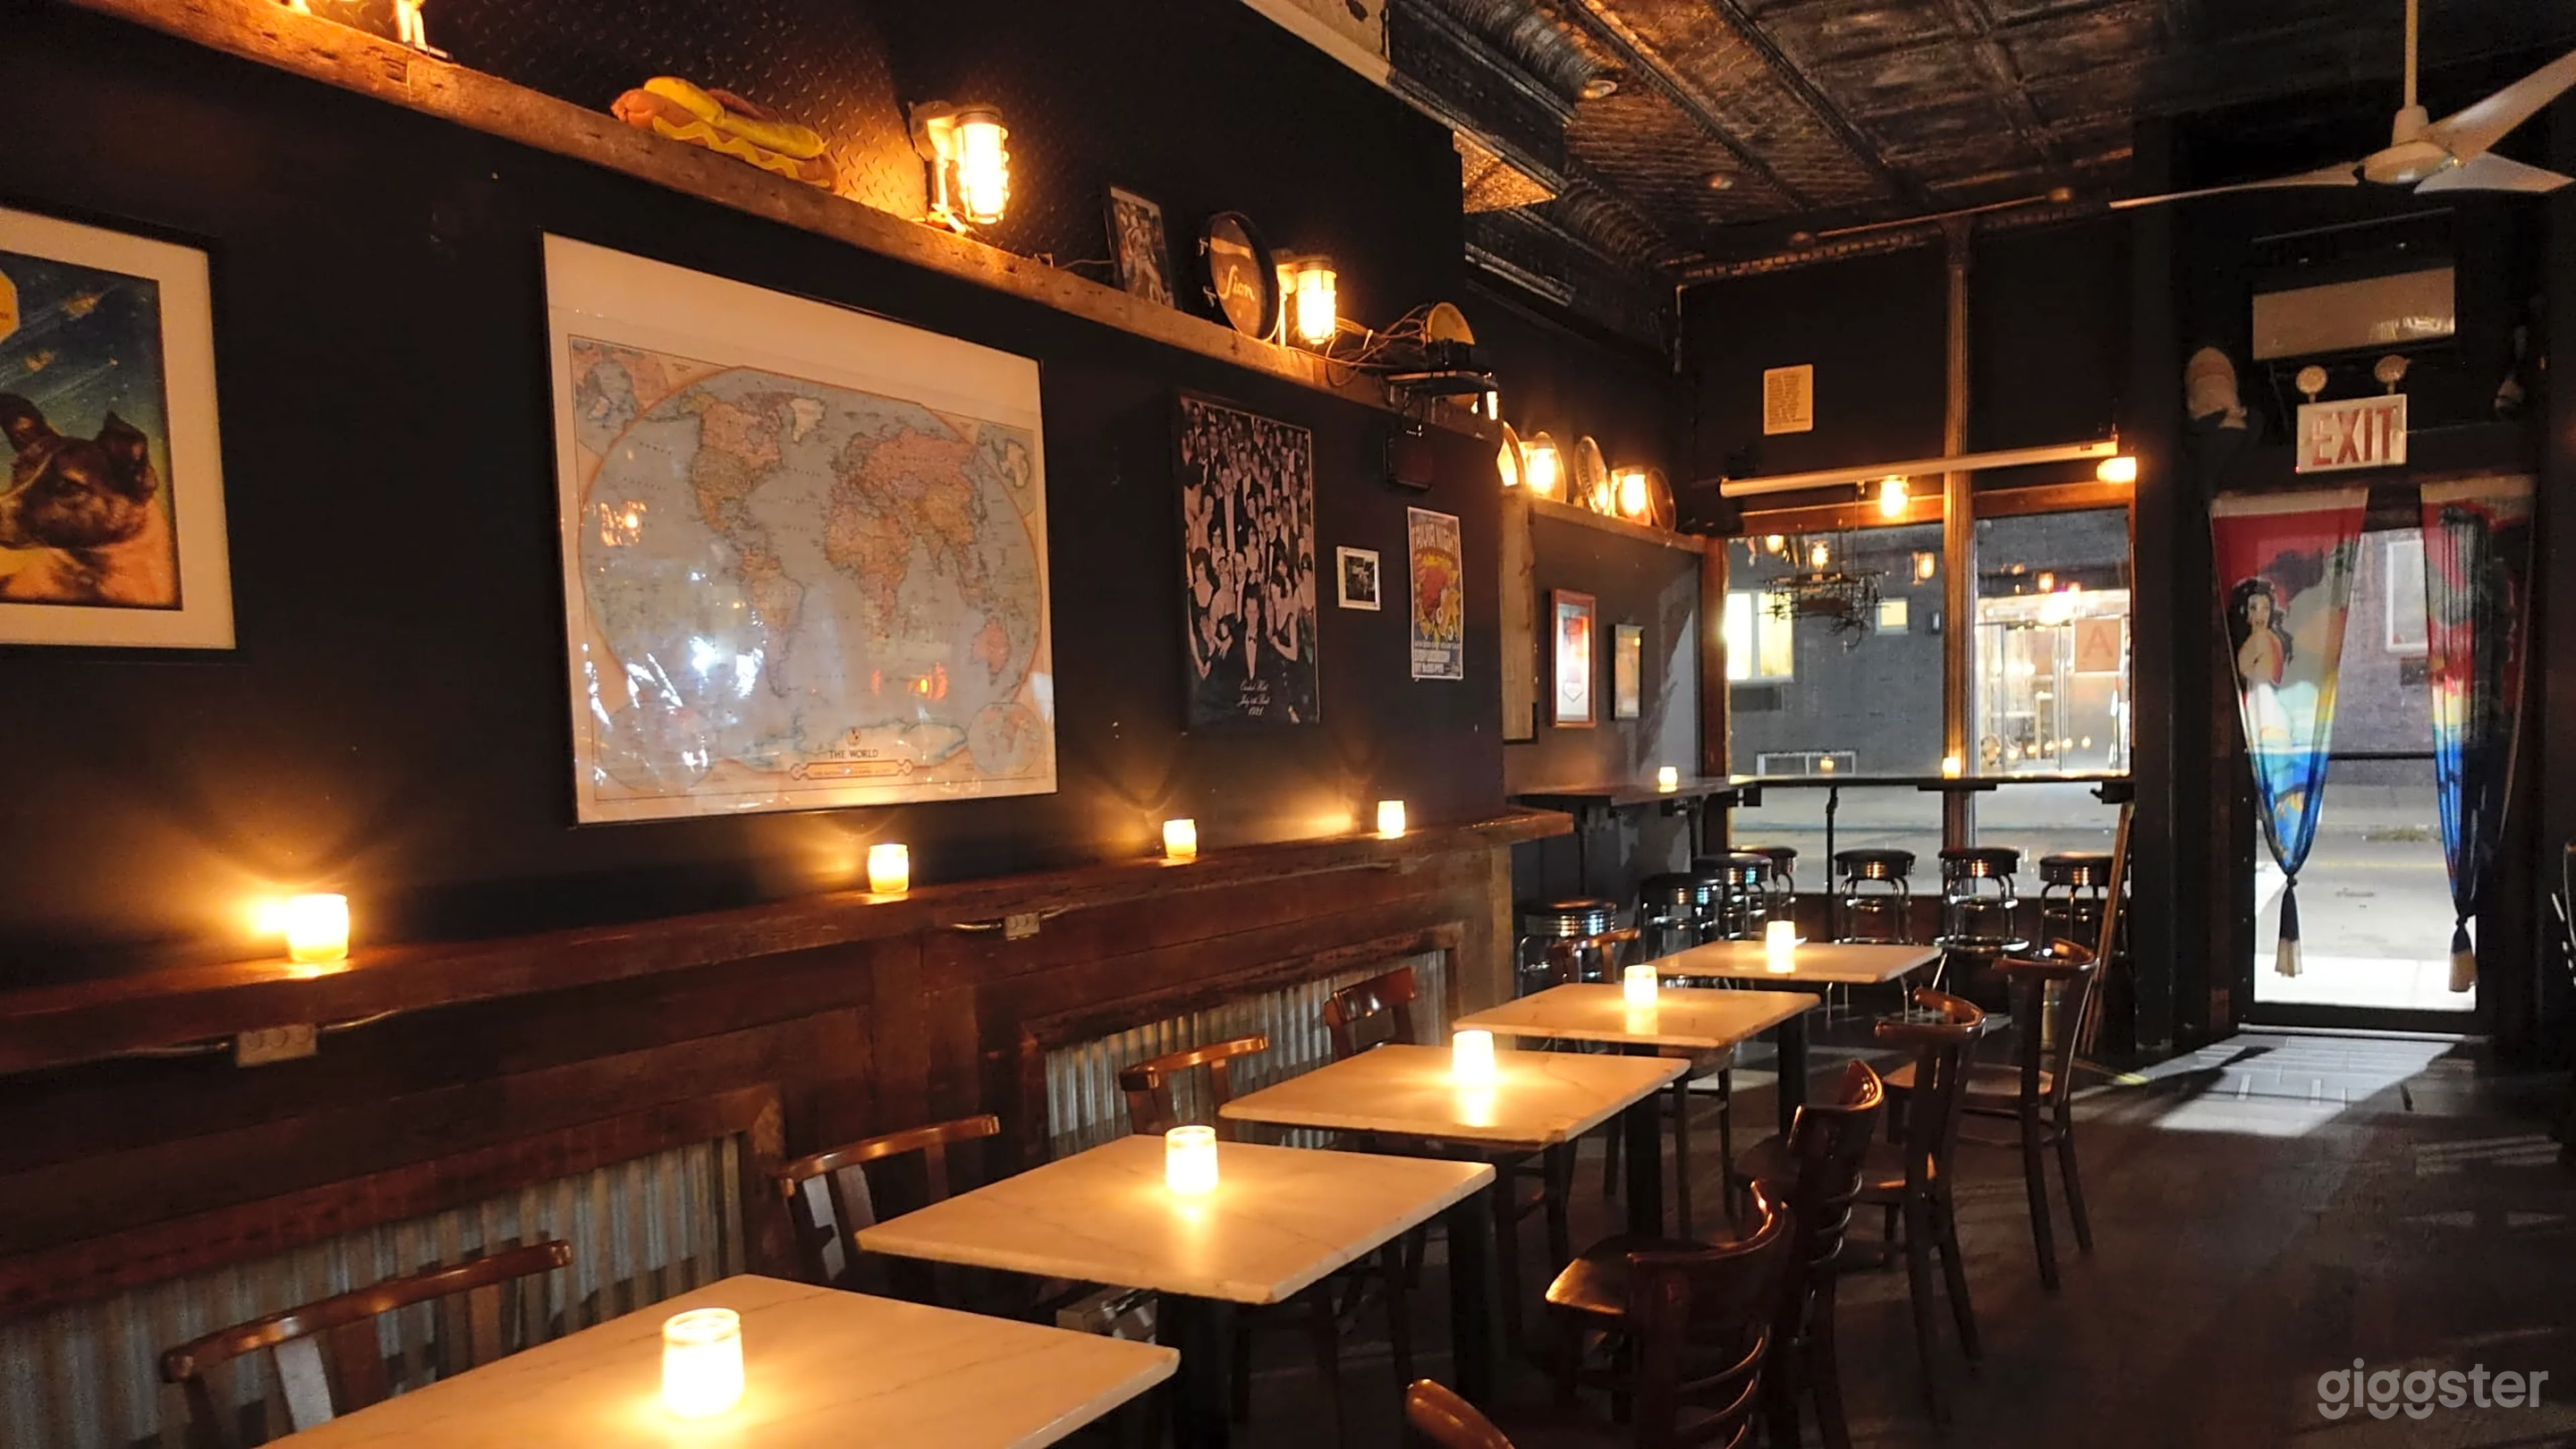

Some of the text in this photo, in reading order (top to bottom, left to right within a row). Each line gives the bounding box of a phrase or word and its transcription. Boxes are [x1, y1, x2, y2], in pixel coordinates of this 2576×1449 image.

[1216, 264, 1256, 301] Sion
[2310, 405, 2398, 466] EXIT
[2082, 625, 2114, 657] A
[829, 749, 878, 758] THE WORLD
